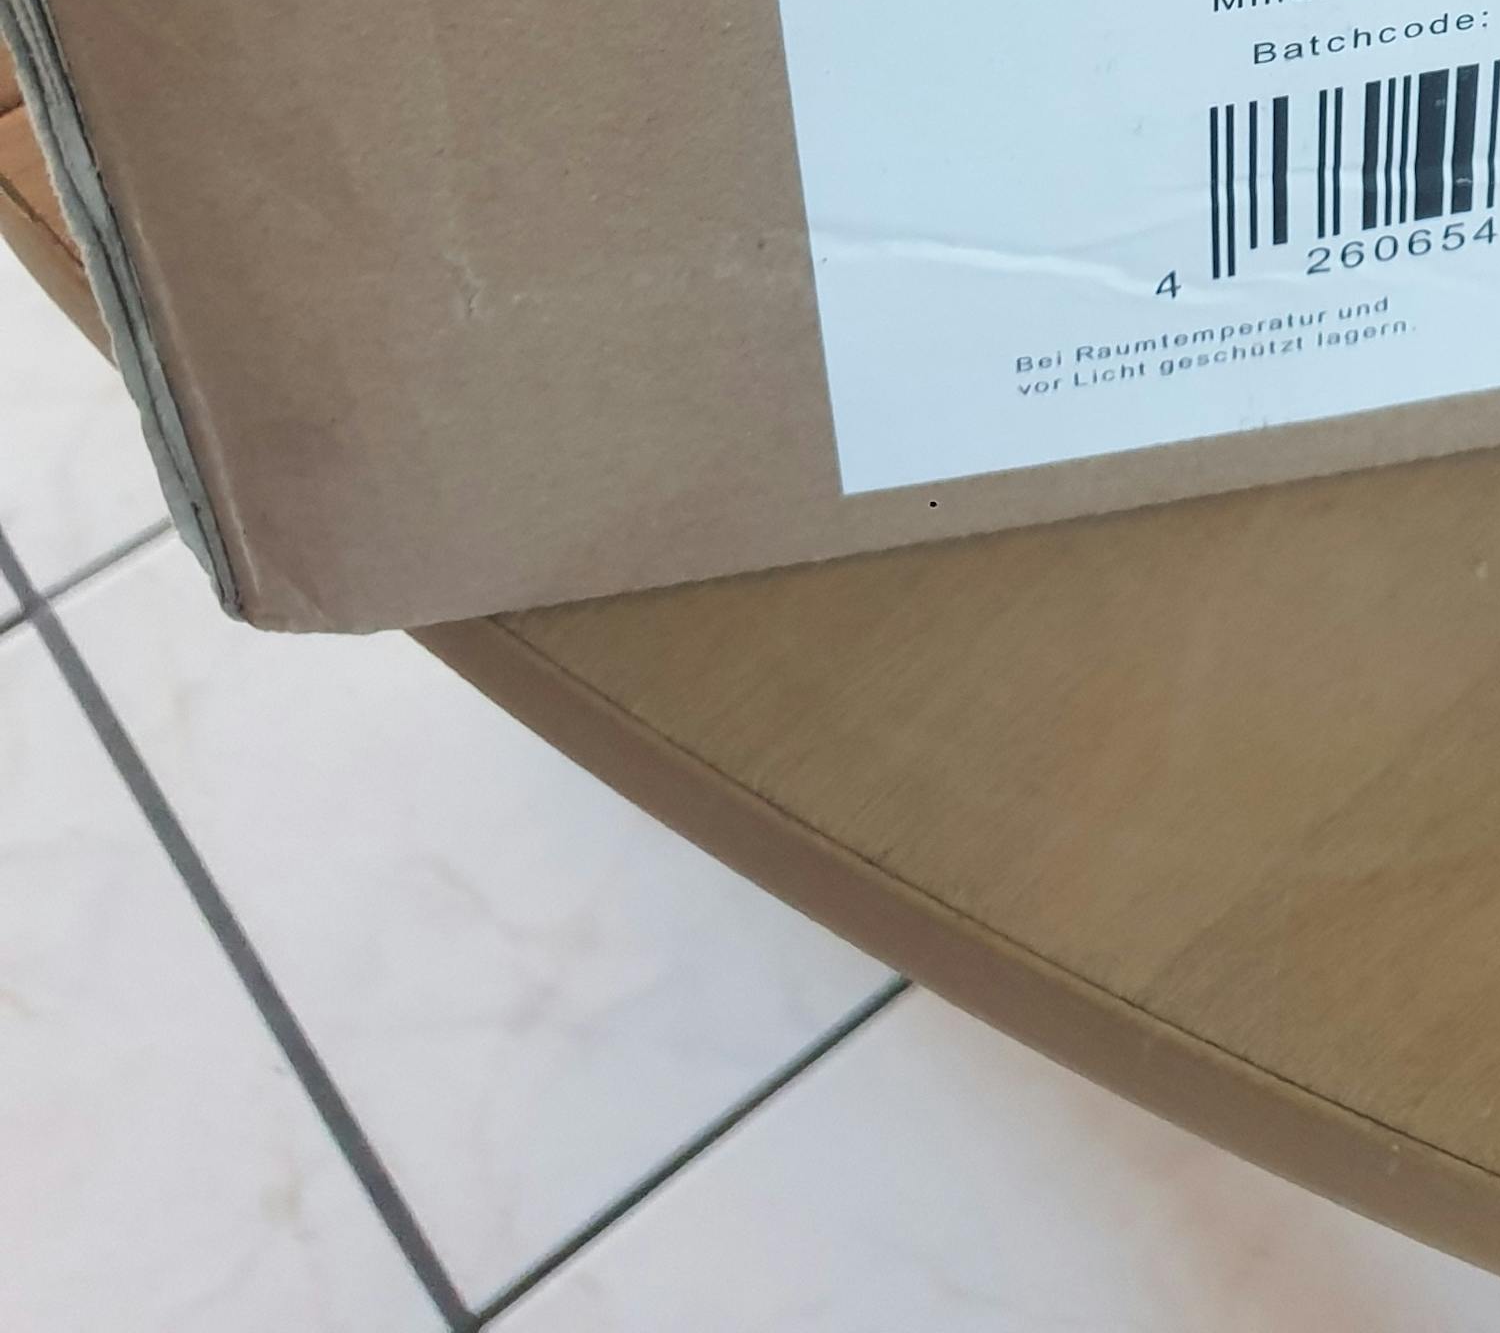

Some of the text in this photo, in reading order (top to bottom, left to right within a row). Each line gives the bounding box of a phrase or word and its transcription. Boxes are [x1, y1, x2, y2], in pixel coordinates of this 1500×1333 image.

[1253, 4, 1491, 65] Batchcode:
[1155, 270, 1182, 300] 4
[1306, 216, 1499, 276] 260654
[1015, 296, 1390, 374] Bei Raumtemperatur und
[1017, 319, 1417, 396] vor Licht geschützt lagern.
